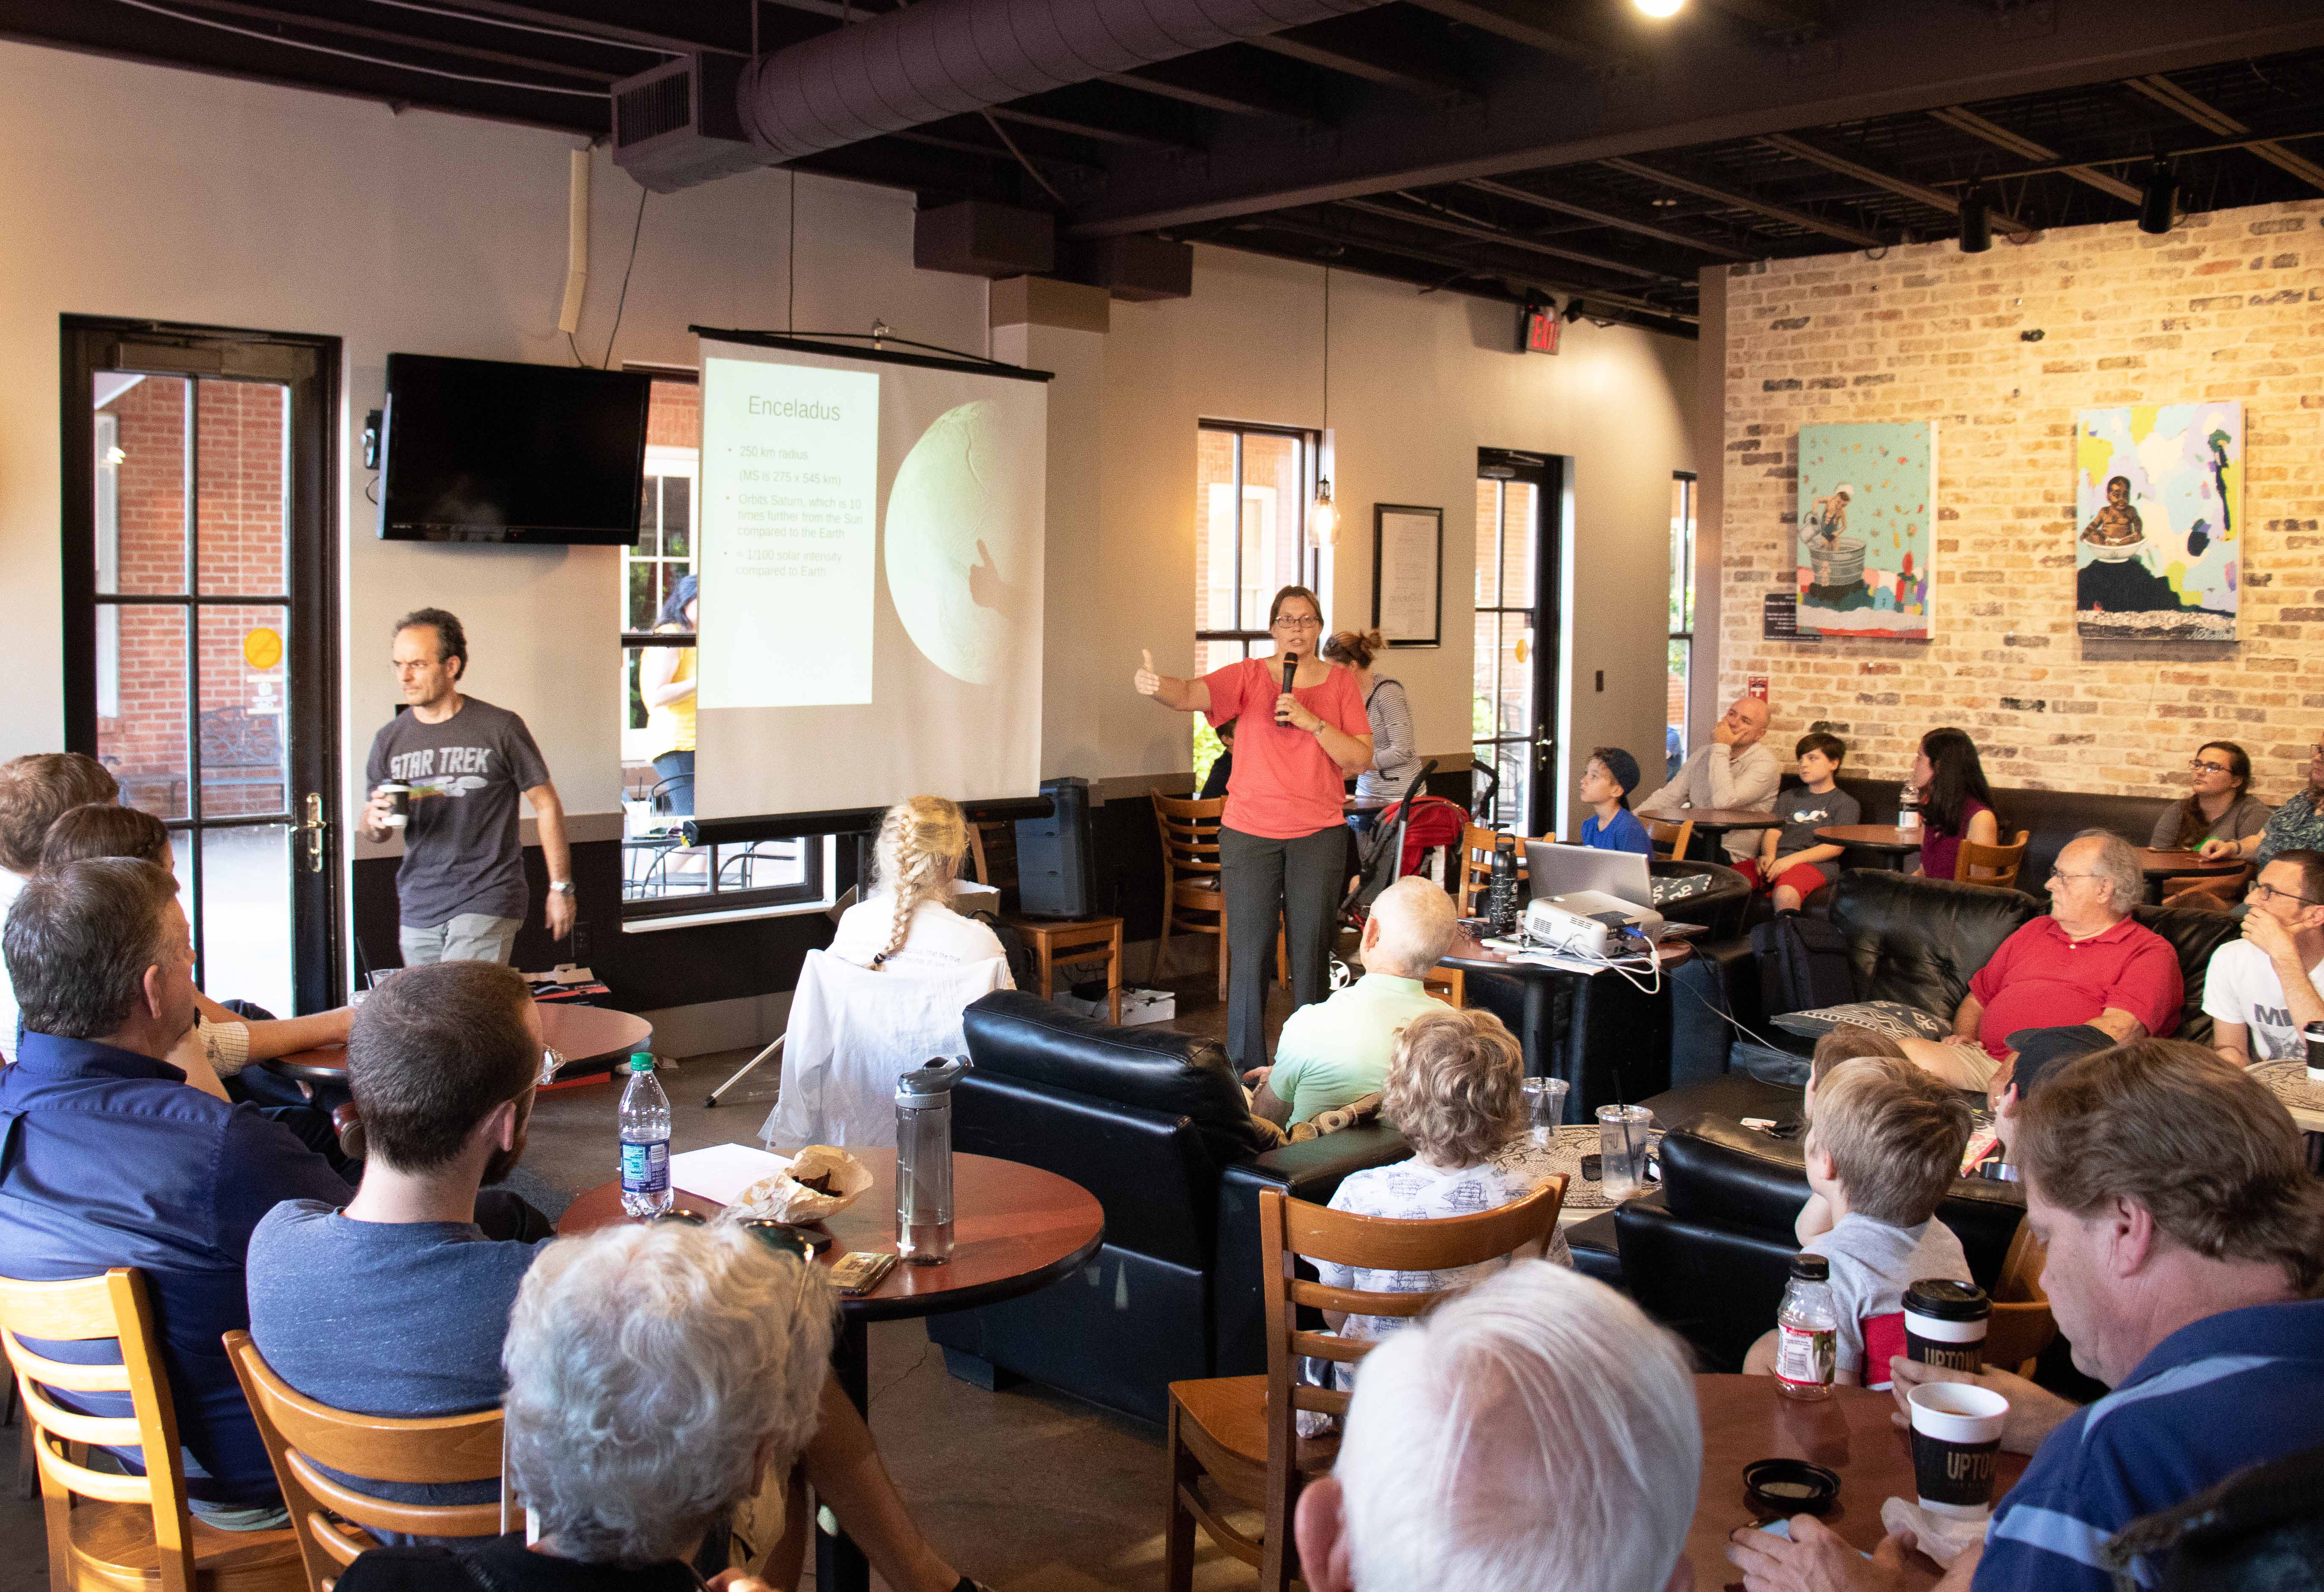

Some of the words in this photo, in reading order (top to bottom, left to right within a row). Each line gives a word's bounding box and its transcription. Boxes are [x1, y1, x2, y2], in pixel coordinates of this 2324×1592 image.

[749, 395, 840, 421] Enceladus
[740, 446, 758, 457] 250
[761, 447, 775, 458] km
[779, 449, 808, 460] radius
[739, 469, 759, 483] (MS
[762, 471, 770, 482] is
[773, 471, 792, 482] 275
[803, 473, 820, 484] 545
[823, 474, 841, 487] km)
[739, 494, 768, 505] Orbits
[809, 497, 835, 508] which
[839, 499, 846, 508] is
[850, 499, 862, 510] 10
[738, 510, 764, 521] times
[767, 510, 799, 522] further
[802, 512, 823, 522] from
[826, 512, 841, 523] the
[844, 513, 863, 525] Sun
[738, 527, 786, 540] compared
[789, 527, 799, 537] to
[802, 527, 816, 537] the
[819, 527, 845, 538] Earth
[747, 549, 774, 560] 1/100
[777, 550, 799, 561] solar
[803, 551, 842, 564] intensity
[736, 565, 786, 577] compared
[789, 566, 798, 576] to
[801, 566, 826, 576] Earth
[391, 749, 435, 779] STAR
[439, 746, 492, 774] TREK
